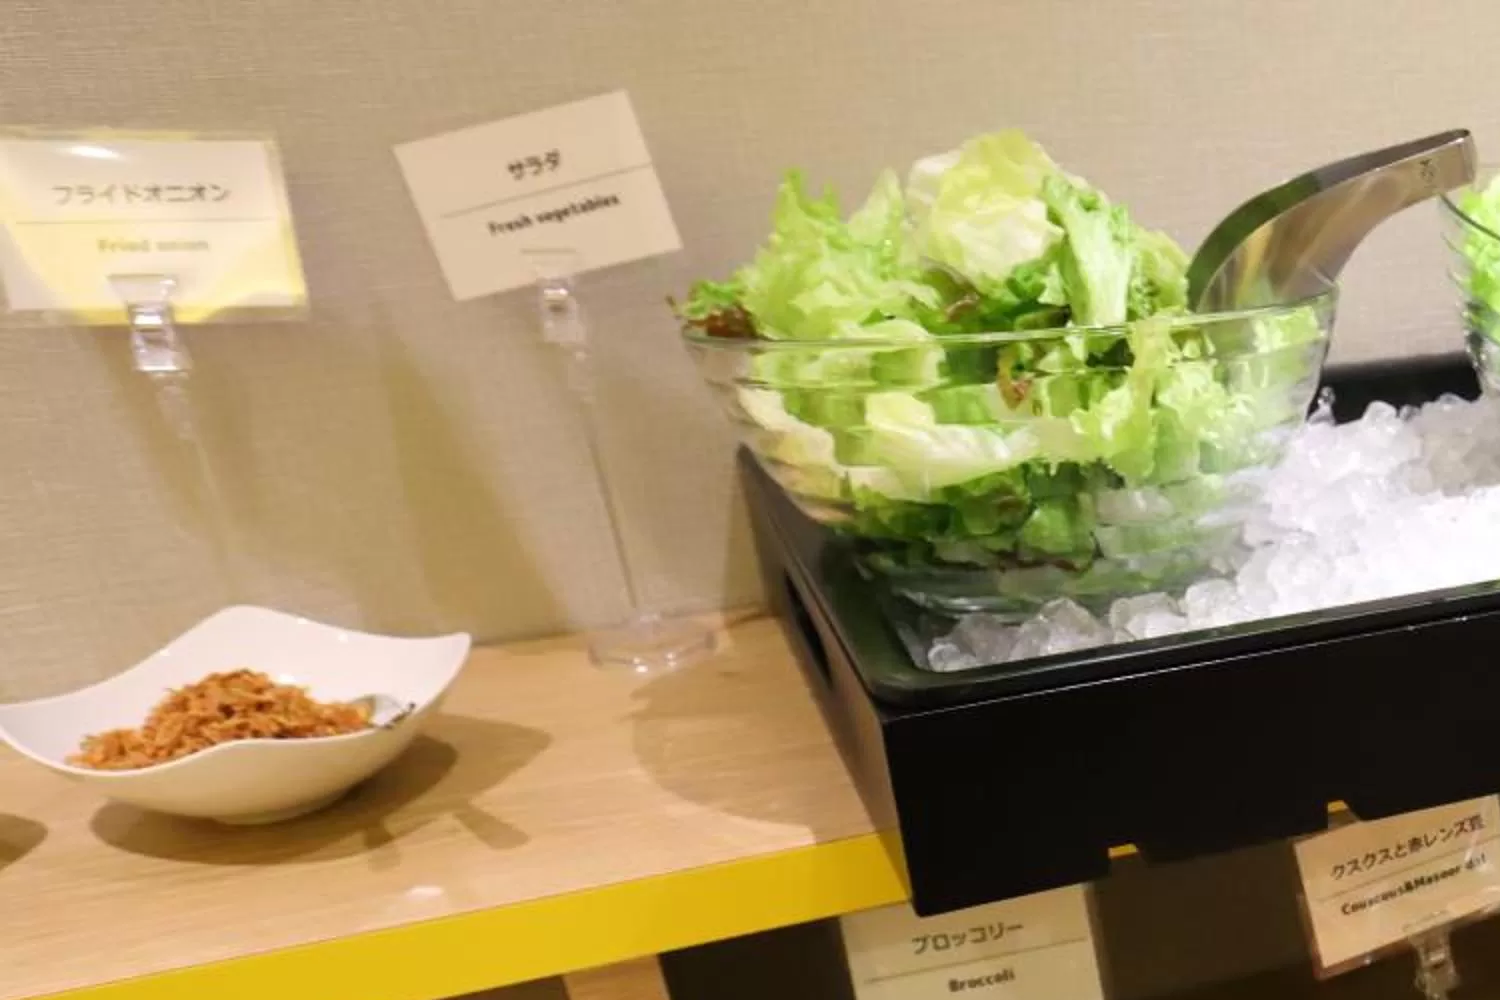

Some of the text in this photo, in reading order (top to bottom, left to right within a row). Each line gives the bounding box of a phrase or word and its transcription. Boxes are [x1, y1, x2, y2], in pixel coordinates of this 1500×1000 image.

[506, 149, 560, 180] サラダ
[52, 183, 232, 205] フライドオニオン
[486, 193, 621, 236] Fresh vegetables
[911, 921, 1024, 955] ブロッコリー
[948, 968, 1016, 993] Broccoli
